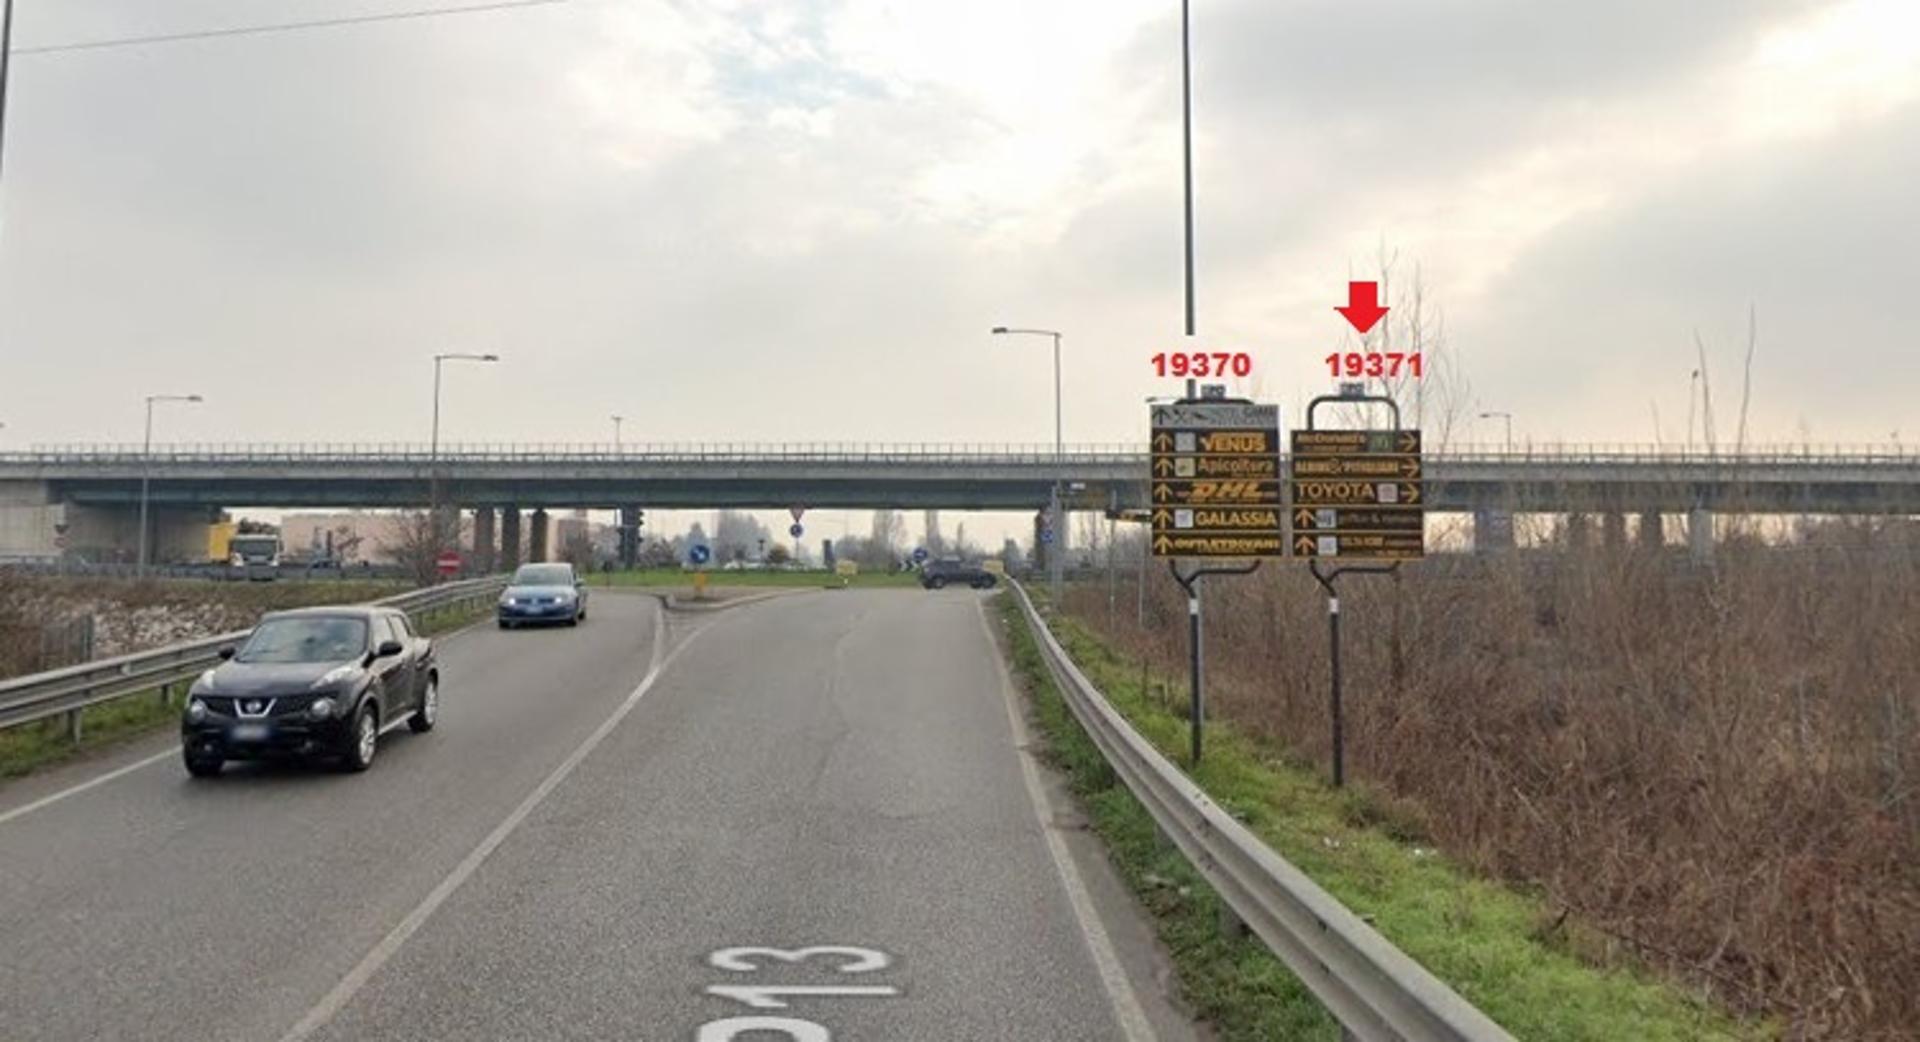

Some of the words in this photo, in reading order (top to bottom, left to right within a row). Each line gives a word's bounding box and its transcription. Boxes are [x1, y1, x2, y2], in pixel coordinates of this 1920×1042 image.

[1200, 436, 1266, 452] VENUS
[1297, 483, 1376, 499] TOYOTA
[1195, 511, 1278, 527] GALASSIA
